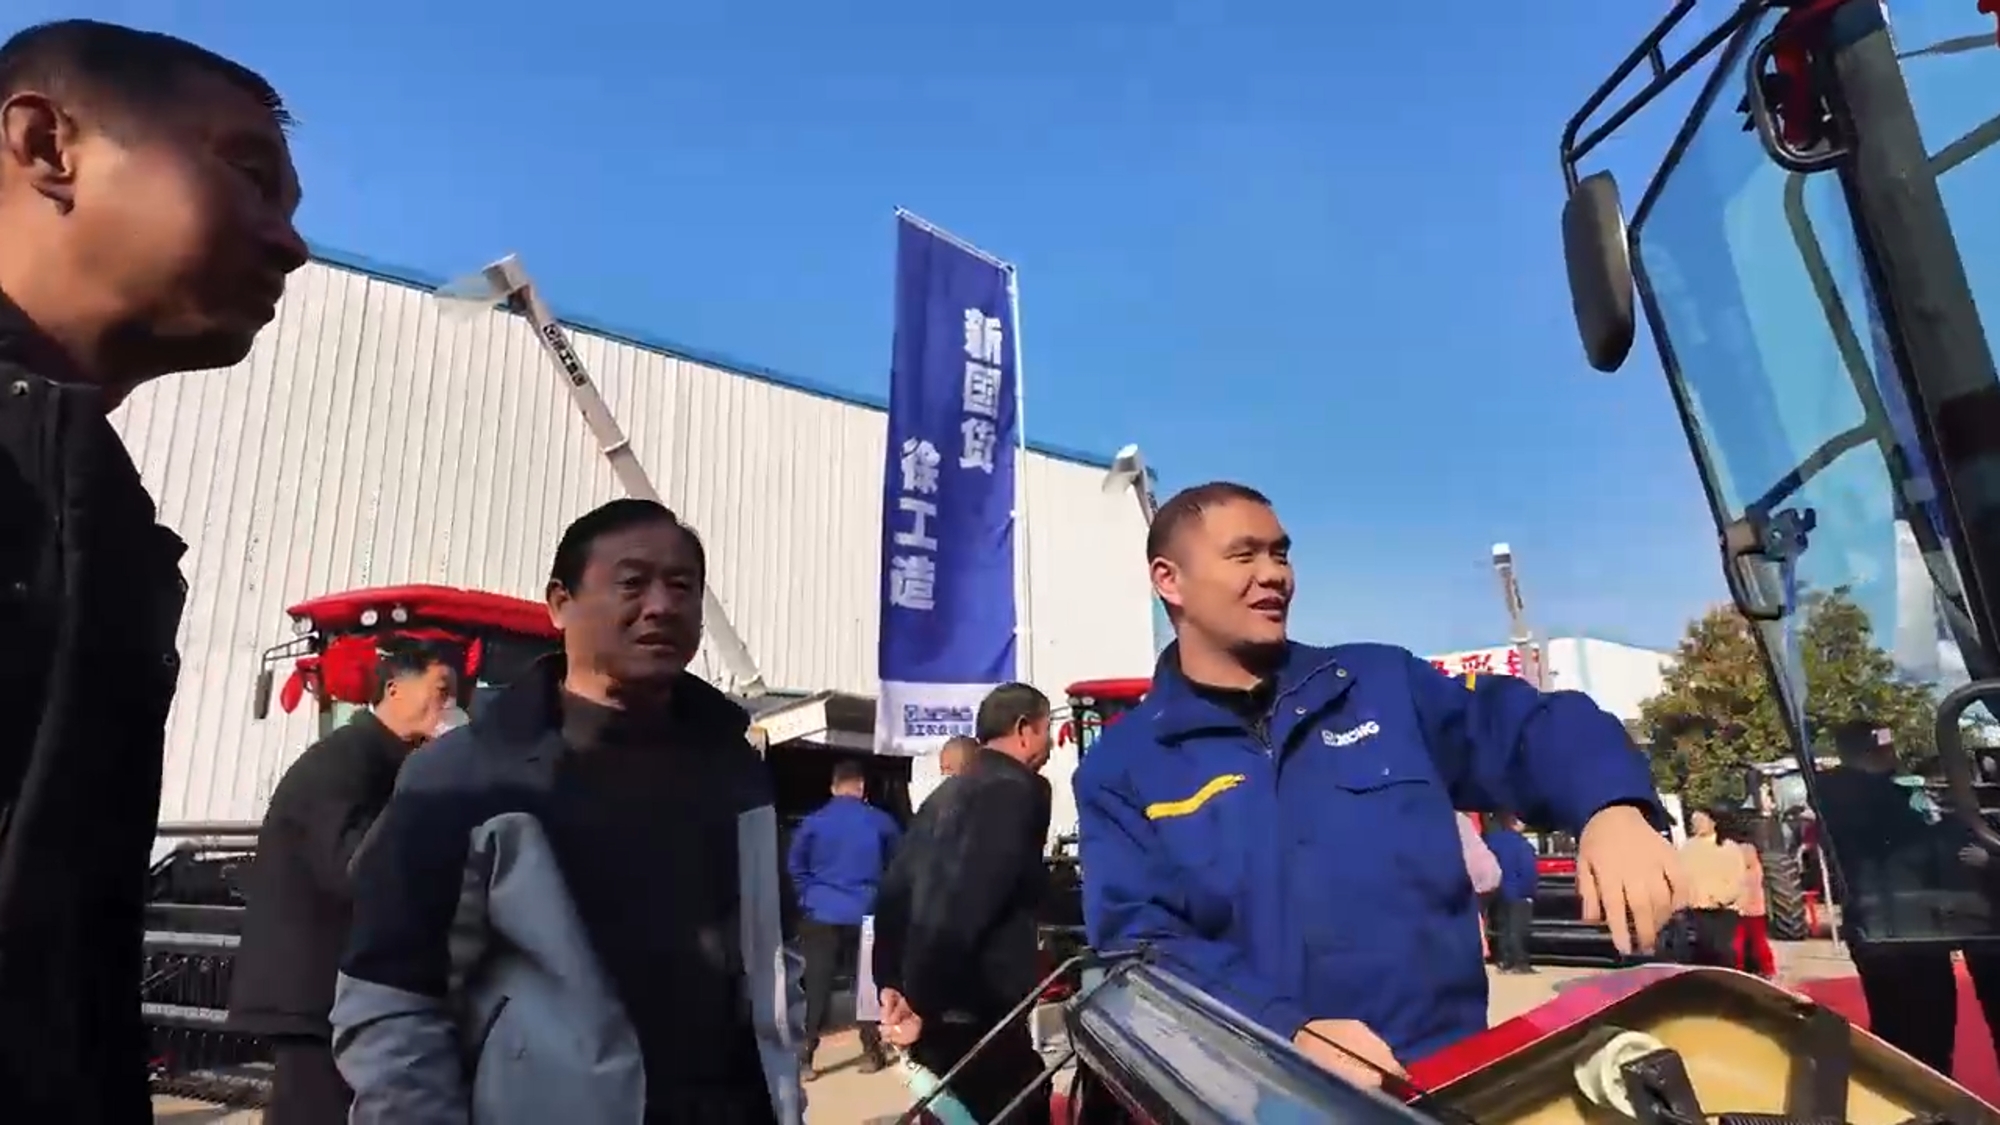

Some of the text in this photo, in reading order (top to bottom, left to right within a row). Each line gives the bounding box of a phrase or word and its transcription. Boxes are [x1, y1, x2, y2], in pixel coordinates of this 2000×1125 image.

[959, 307, 1002, 474] 新国货
[890, 436, 941, 610] 徐工造
